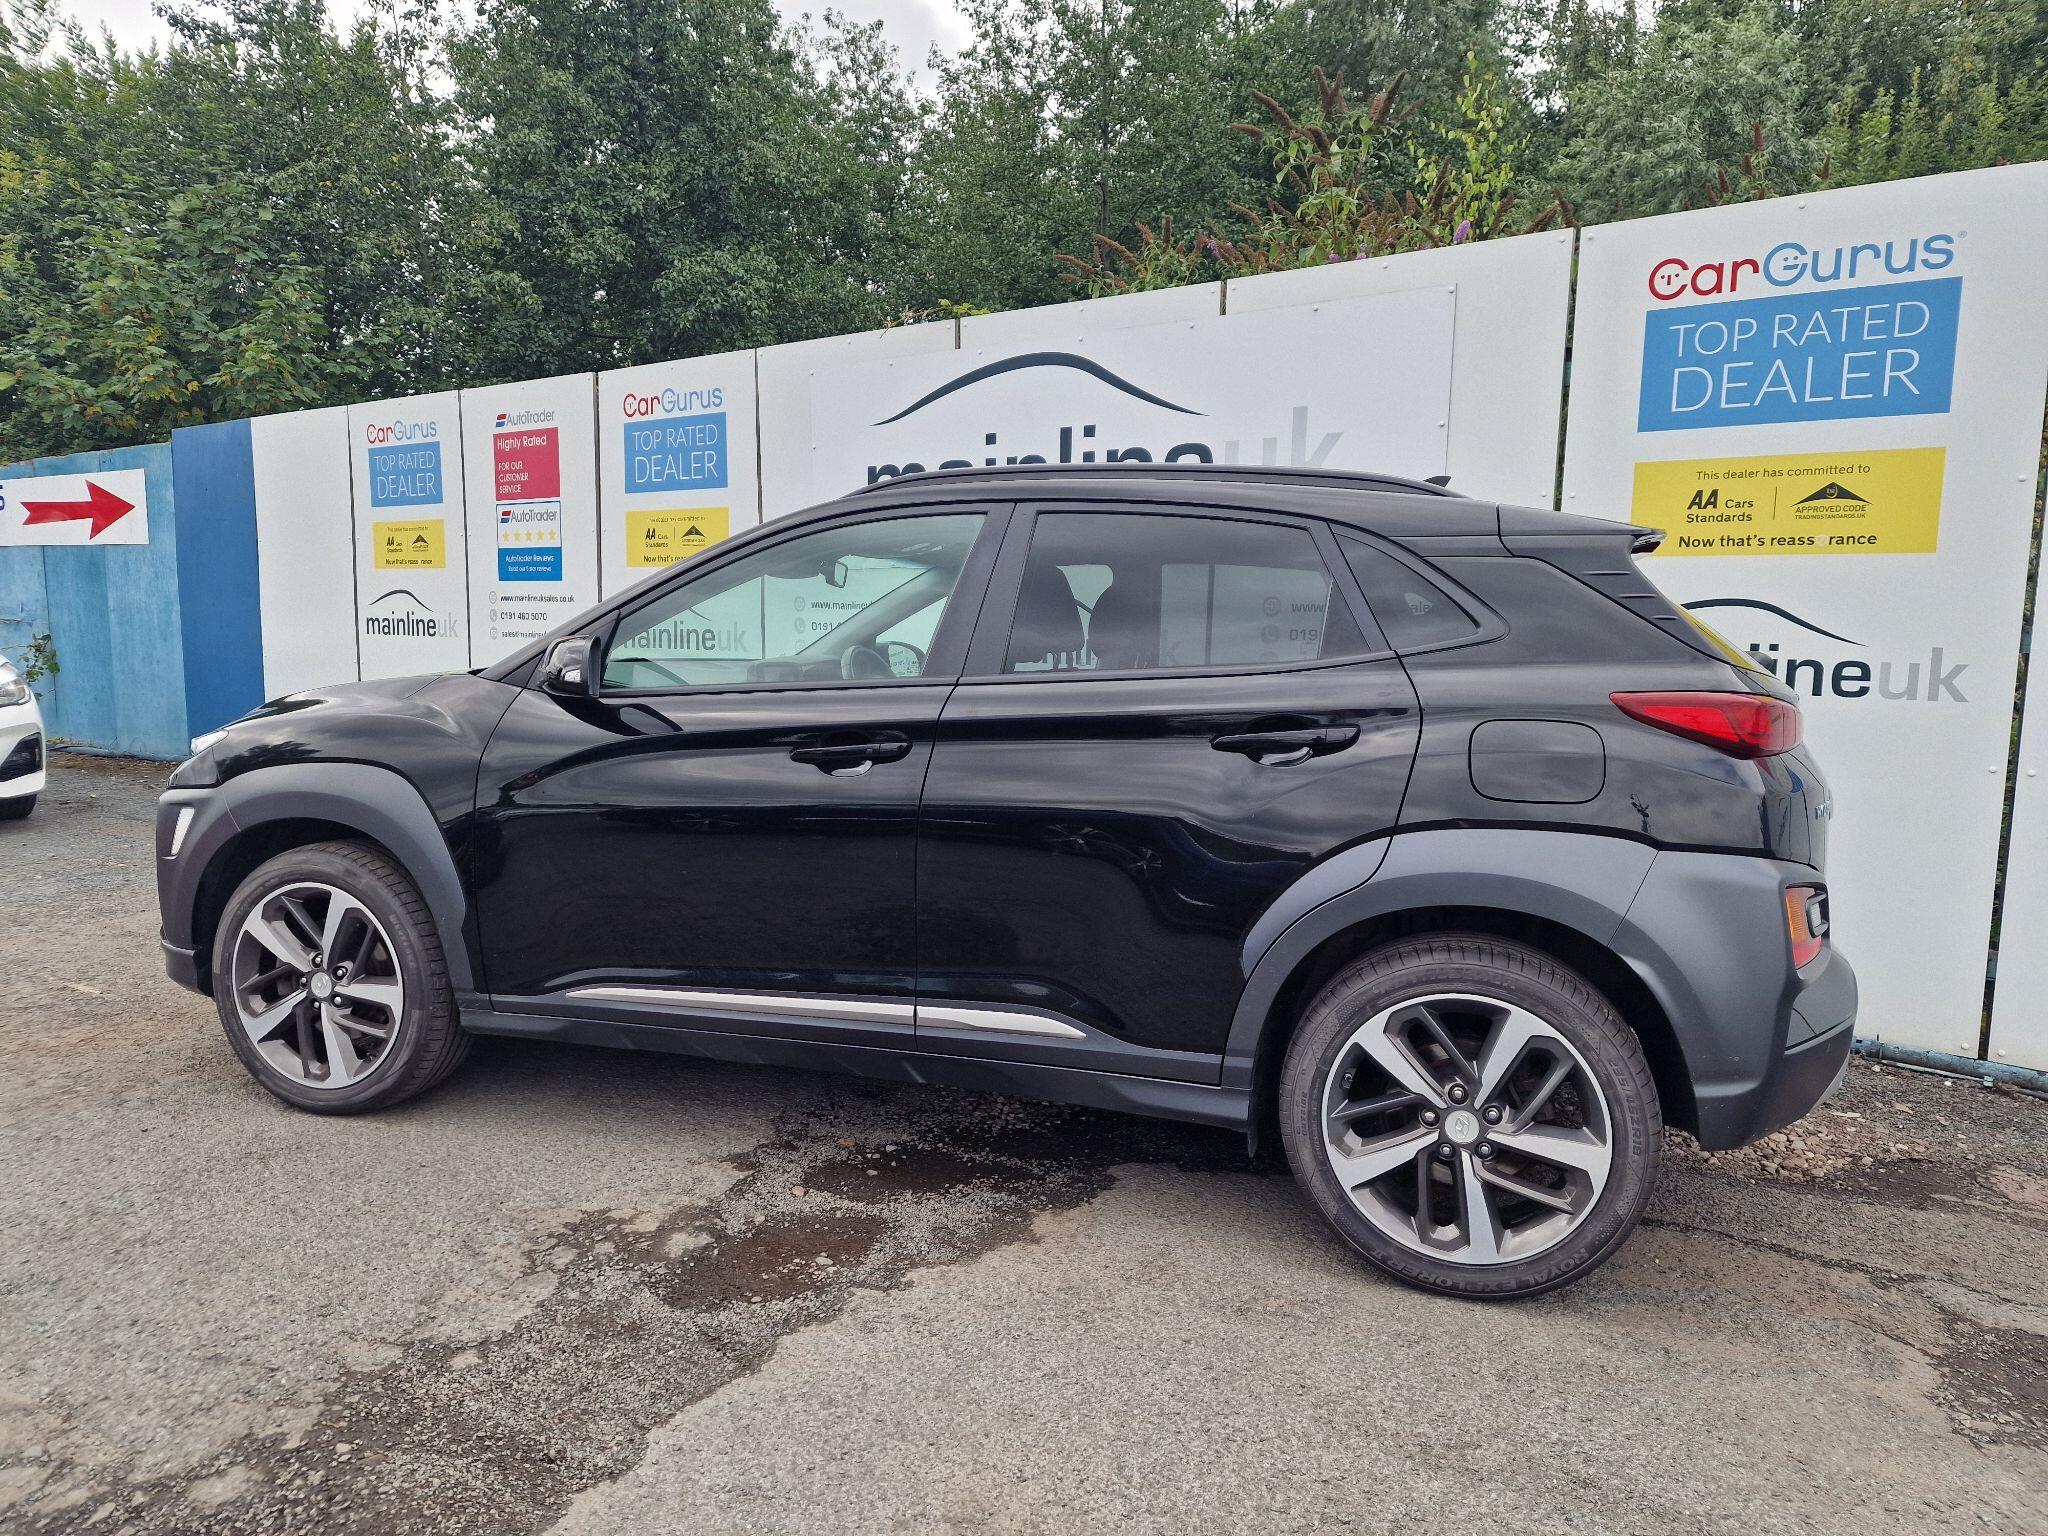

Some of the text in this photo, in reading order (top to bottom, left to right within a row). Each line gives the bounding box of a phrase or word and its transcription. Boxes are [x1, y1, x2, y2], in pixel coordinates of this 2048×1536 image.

[1669, 301, 1930, 358] TOP RATED
[1671, 348, 1920, 413] DEALER
[623, 387, 723, 418] CarGurus
[506, 408, 555, 427] AutoTrader
[366, 420, 437, 444] CarGurus
[631, 424, 718, 451] TOP RATED
[497, 434, 547, 451] Highly Rated
[373, 450, 435, 472] TOP RATED
[498, 461, 523, 470] FOR OUR
[634, 451, 718, 483] DEALER
[499, 473, 528, 482] CUSTOMER
[1695, 464, 1871, 480] This dealer has committed to
[377, 472, 437, 499] DEALER
[499, 484, 522, 493] SERVICE
[1686, 488, 1754, 510] AA Cars
[1795, 504, 1867, 513] APPROVED CODE
[511, 508, 558, 523] AutoTrader
[1686, 512, 1753, 523] Standards
[1679, 535, 1716, 548] Now
[1719, 534, 1766, 548] that's
